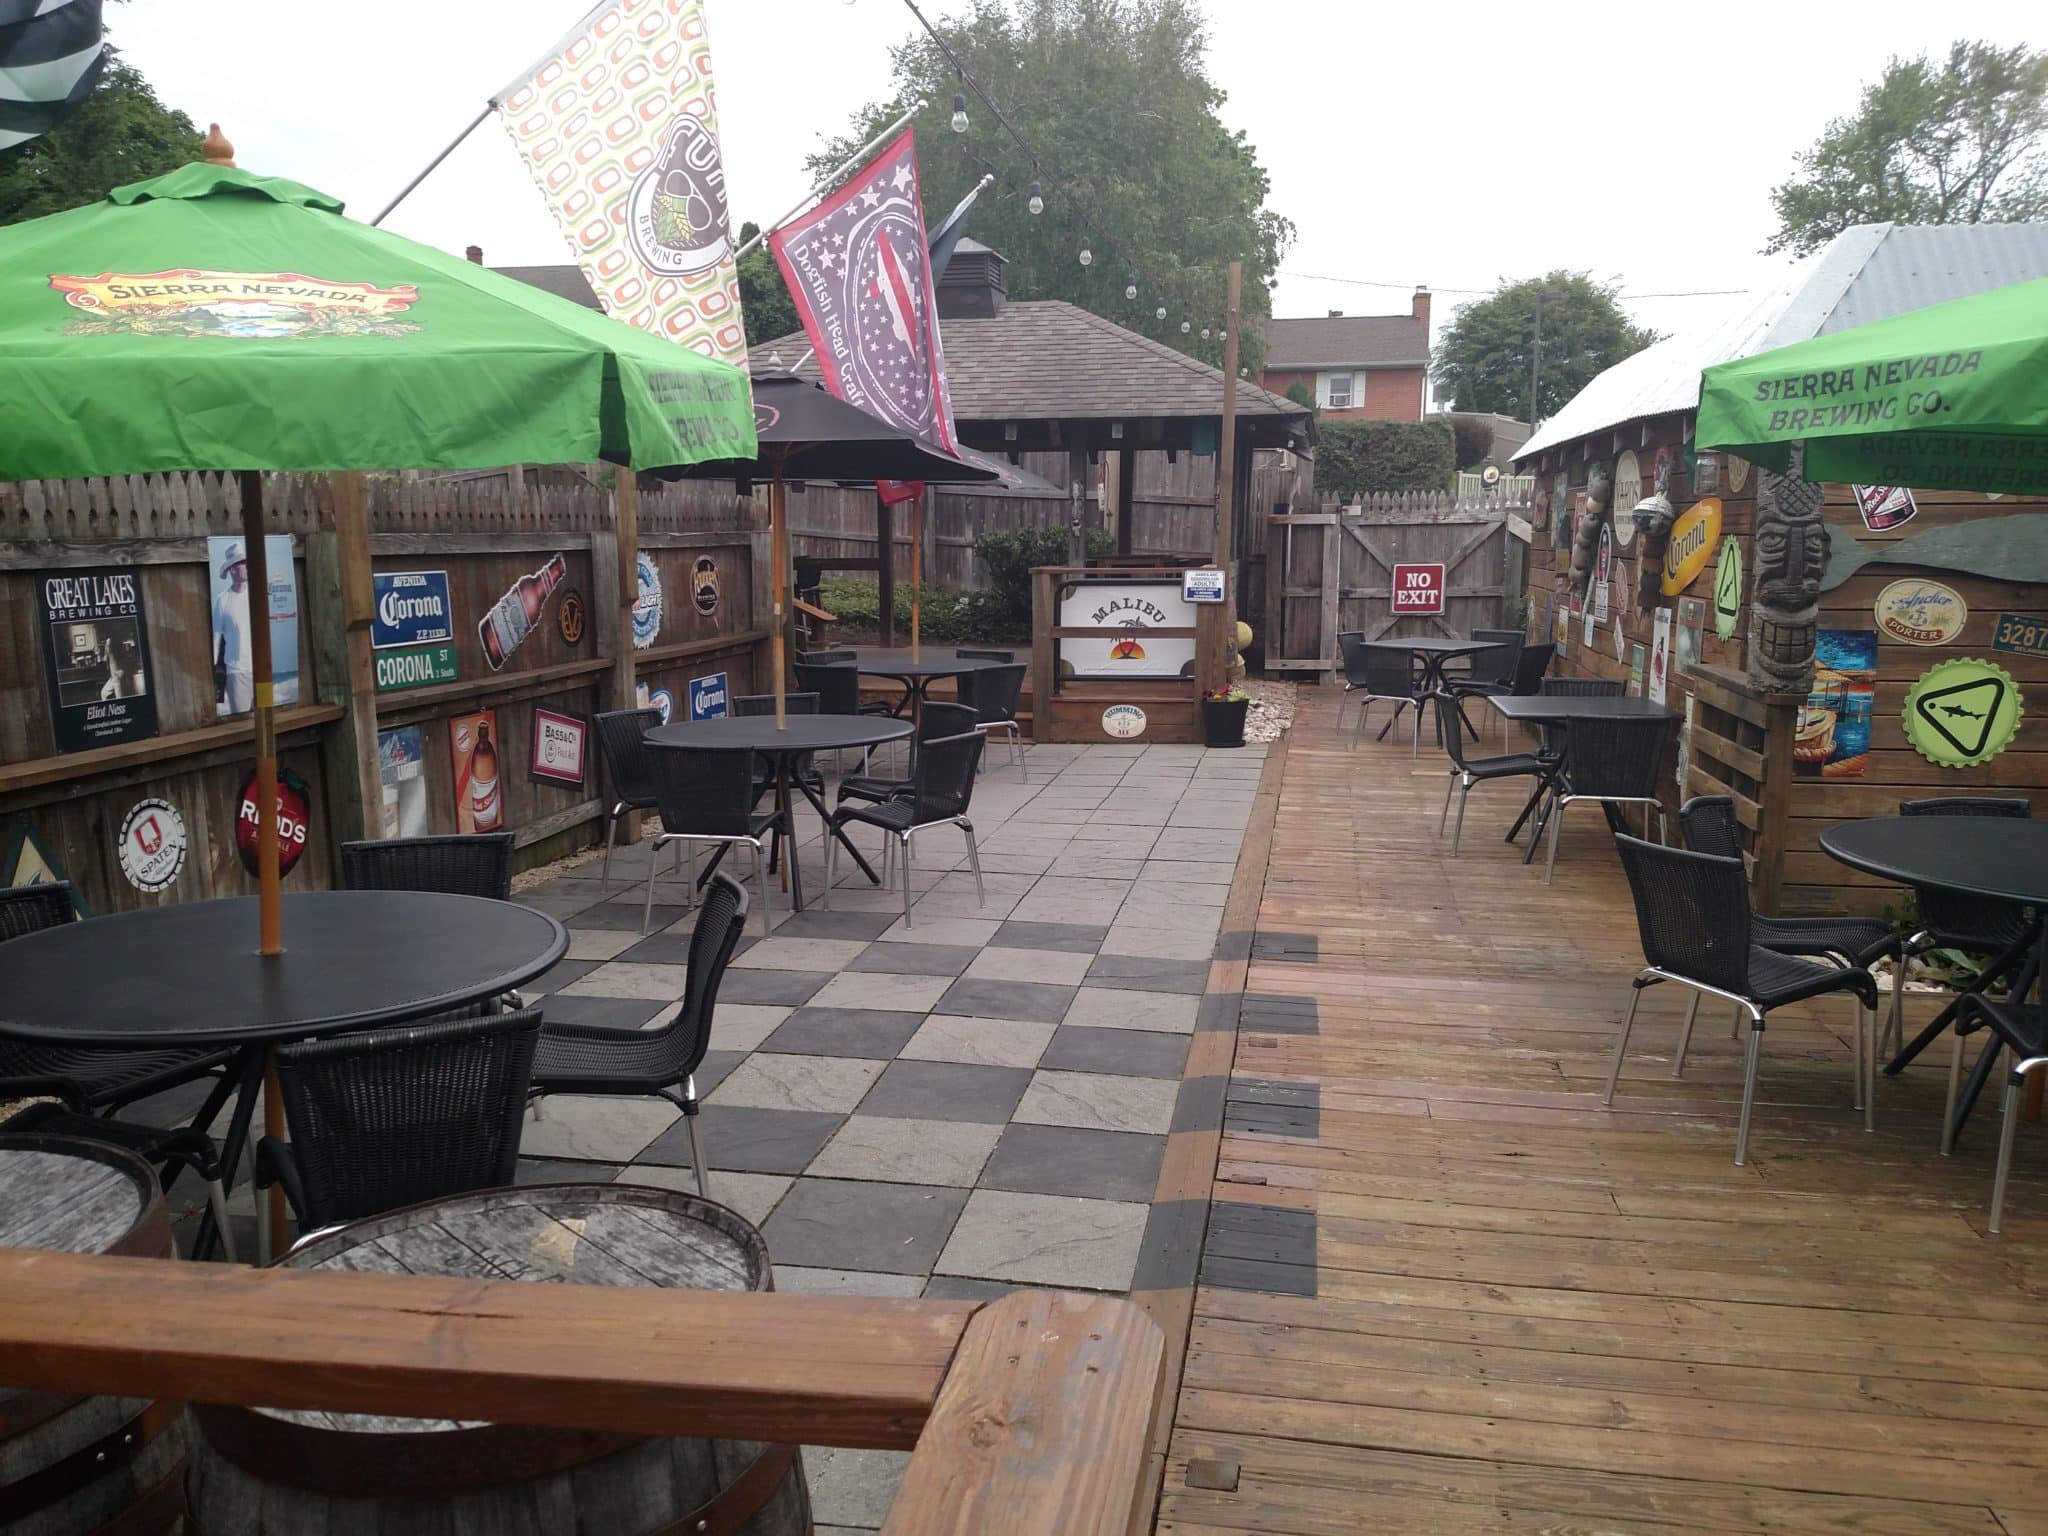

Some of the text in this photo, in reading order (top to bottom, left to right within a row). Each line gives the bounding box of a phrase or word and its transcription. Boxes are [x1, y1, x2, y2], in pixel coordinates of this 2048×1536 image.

[639, 214, 683, 266] BREWING
[107, 283, 369, 304] SIERRA NEVADA
[793, 244, 866, 407] Dogfish Head Craft
[1753, 350, 1985, 402] SIERRA NEVADA
[1767, 389, 1953, 433] BREWING CO.
[1666, 518, 1706, 580] Corona
[46, 574, 136, 610] GREAT LAKES
[392, 575, 428, 588] AVENIDA
[1405, 572, 1431, 588] NO
[379, 591, 444, 630] Corona
[641, 593, 664, 609] LIGHT
[1091, 597, 1167, 625] MALIBU
[1395, 590, 1439, 605] EXIT
[1895, 586, 1953, 609] Anchor
[49, 605, 113, 621] BREWING
[1888, 620, 1944, 641] PORTER
[440, 649, 449, 662] ST
[376, 653, 435, 687] CORONA
[87, 703, 127, 721] Eliot Ness
[695, 689, 725, 716] Corona
[140, 839, 178, 878] SPATEN
